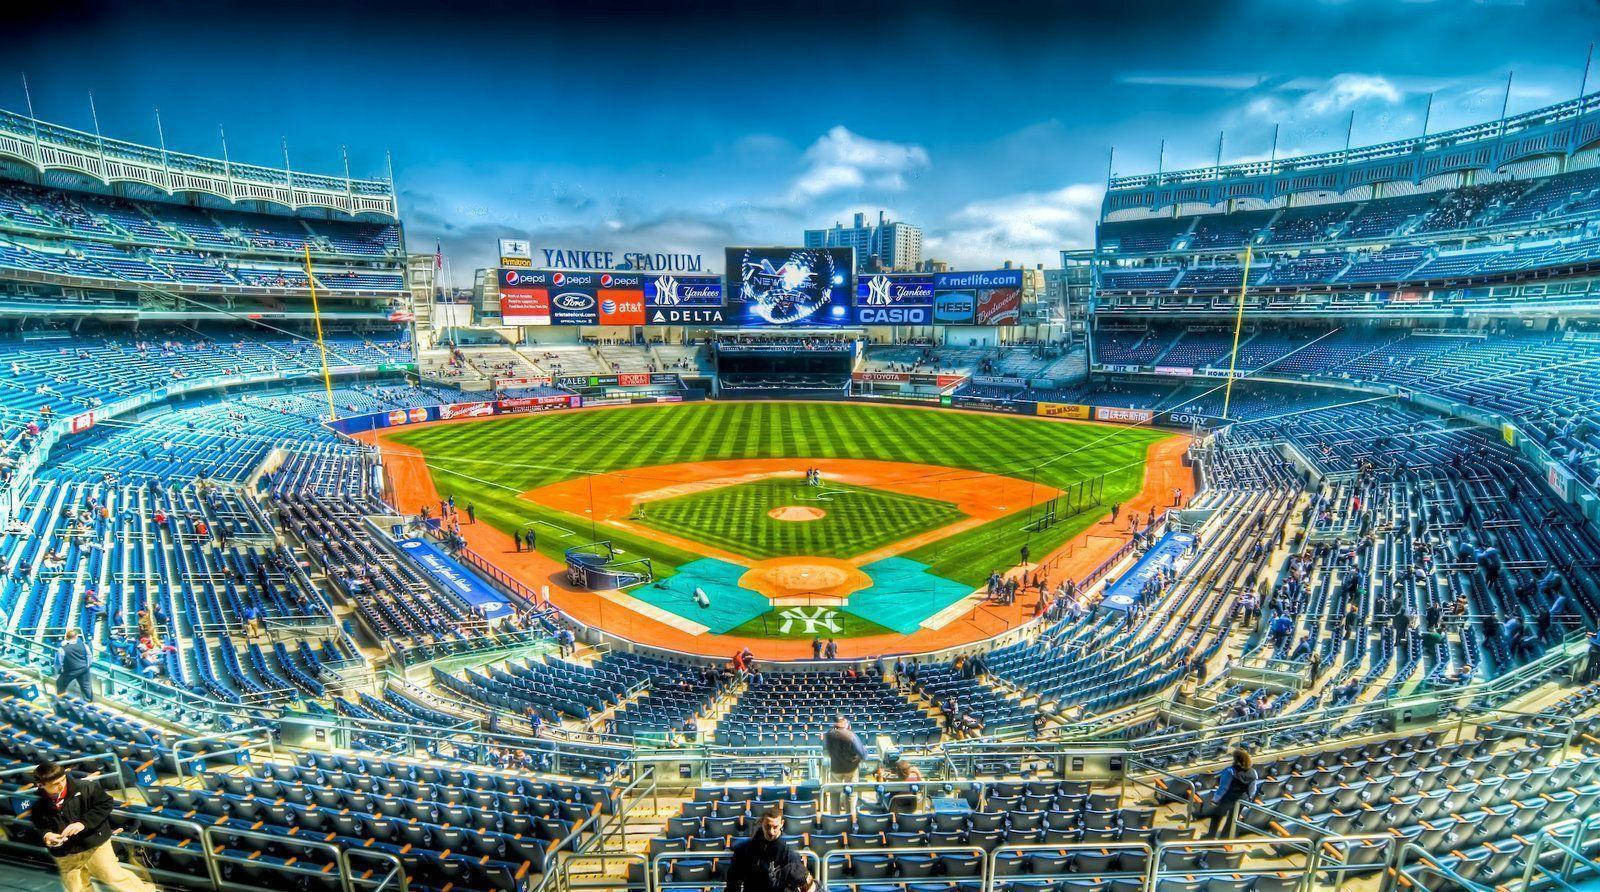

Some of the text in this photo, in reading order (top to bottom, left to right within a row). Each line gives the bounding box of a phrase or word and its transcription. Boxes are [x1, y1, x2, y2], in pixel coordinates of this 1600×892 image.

[502, 257, 531, 267] Armitron
[541, 248, 615, 269] YANKEE
[624, 252, 702, 272] STADIUM
[520, 274, 545, 286] pepsi
[566, 276, 591, 287] pepsi
[614, 277, 639, 288] pepsi
[949, 273, 1017, 287] metlife.com
[684, 287, 720, 302] Yankees
[896, 286, 932, 302] Yankees
[562, 296, 586, 307] Ford
[619, 301, 642, 313] at&t
[937, 303, 972, 312] HESS
[978, 288, 1021, 322] Budweiser
[670, 310, 723, 322] DELTA
[859, 308, 925, 323] CASIO
[560, 376, 586, 386] ZALES
[873, 373, 899, 381] TOYOTA
[1170, 413, 1207, 425] SONY
